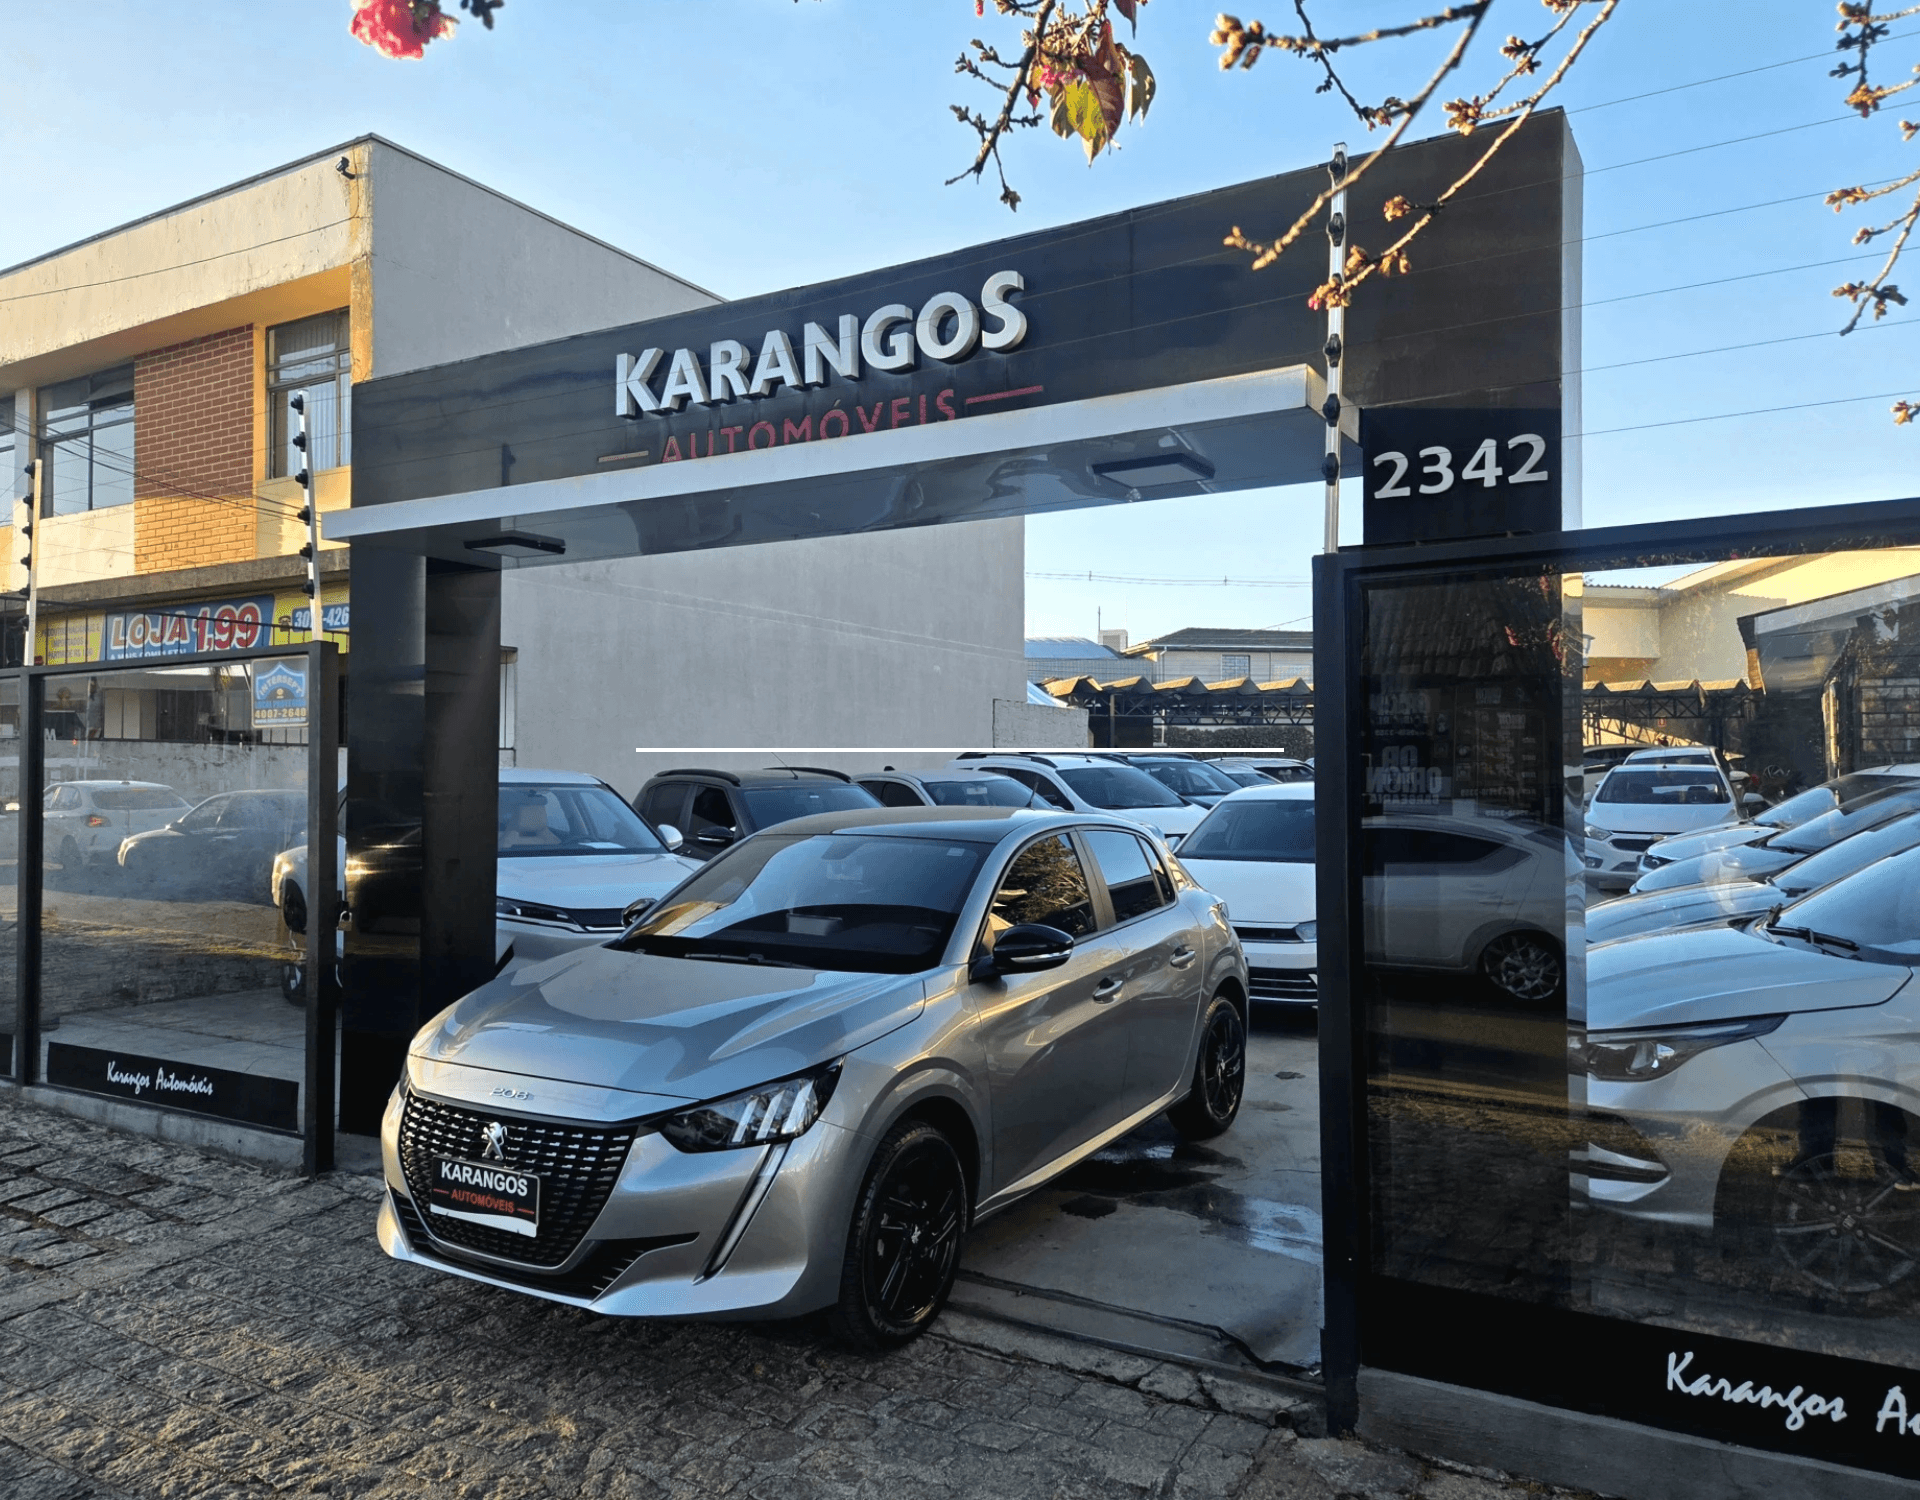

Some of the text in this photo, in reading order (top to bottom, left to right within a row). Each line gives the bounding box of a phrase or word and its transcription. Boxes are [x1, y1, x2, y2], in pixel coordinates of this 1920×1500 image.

[615, 270, 1028, 418] KARANGOS
[661, 388, 957, 463] AUTOMÓVEIS
[1373, 433, 1549, 500] 2342
[110, 602, 262, 653] LOJA 1,99
[294, 606, 350, 628] 30-426
[107, 1060, 214, 1096] Karangos Automóveis
[490, 1087, 531, 1101] 208
[441, 1161, 529, 1197] KARANGOS
[451, 1189, 515, 1214] AUTOMÓVEIS
[1667, 1351, 1848, 1432] Karangos
